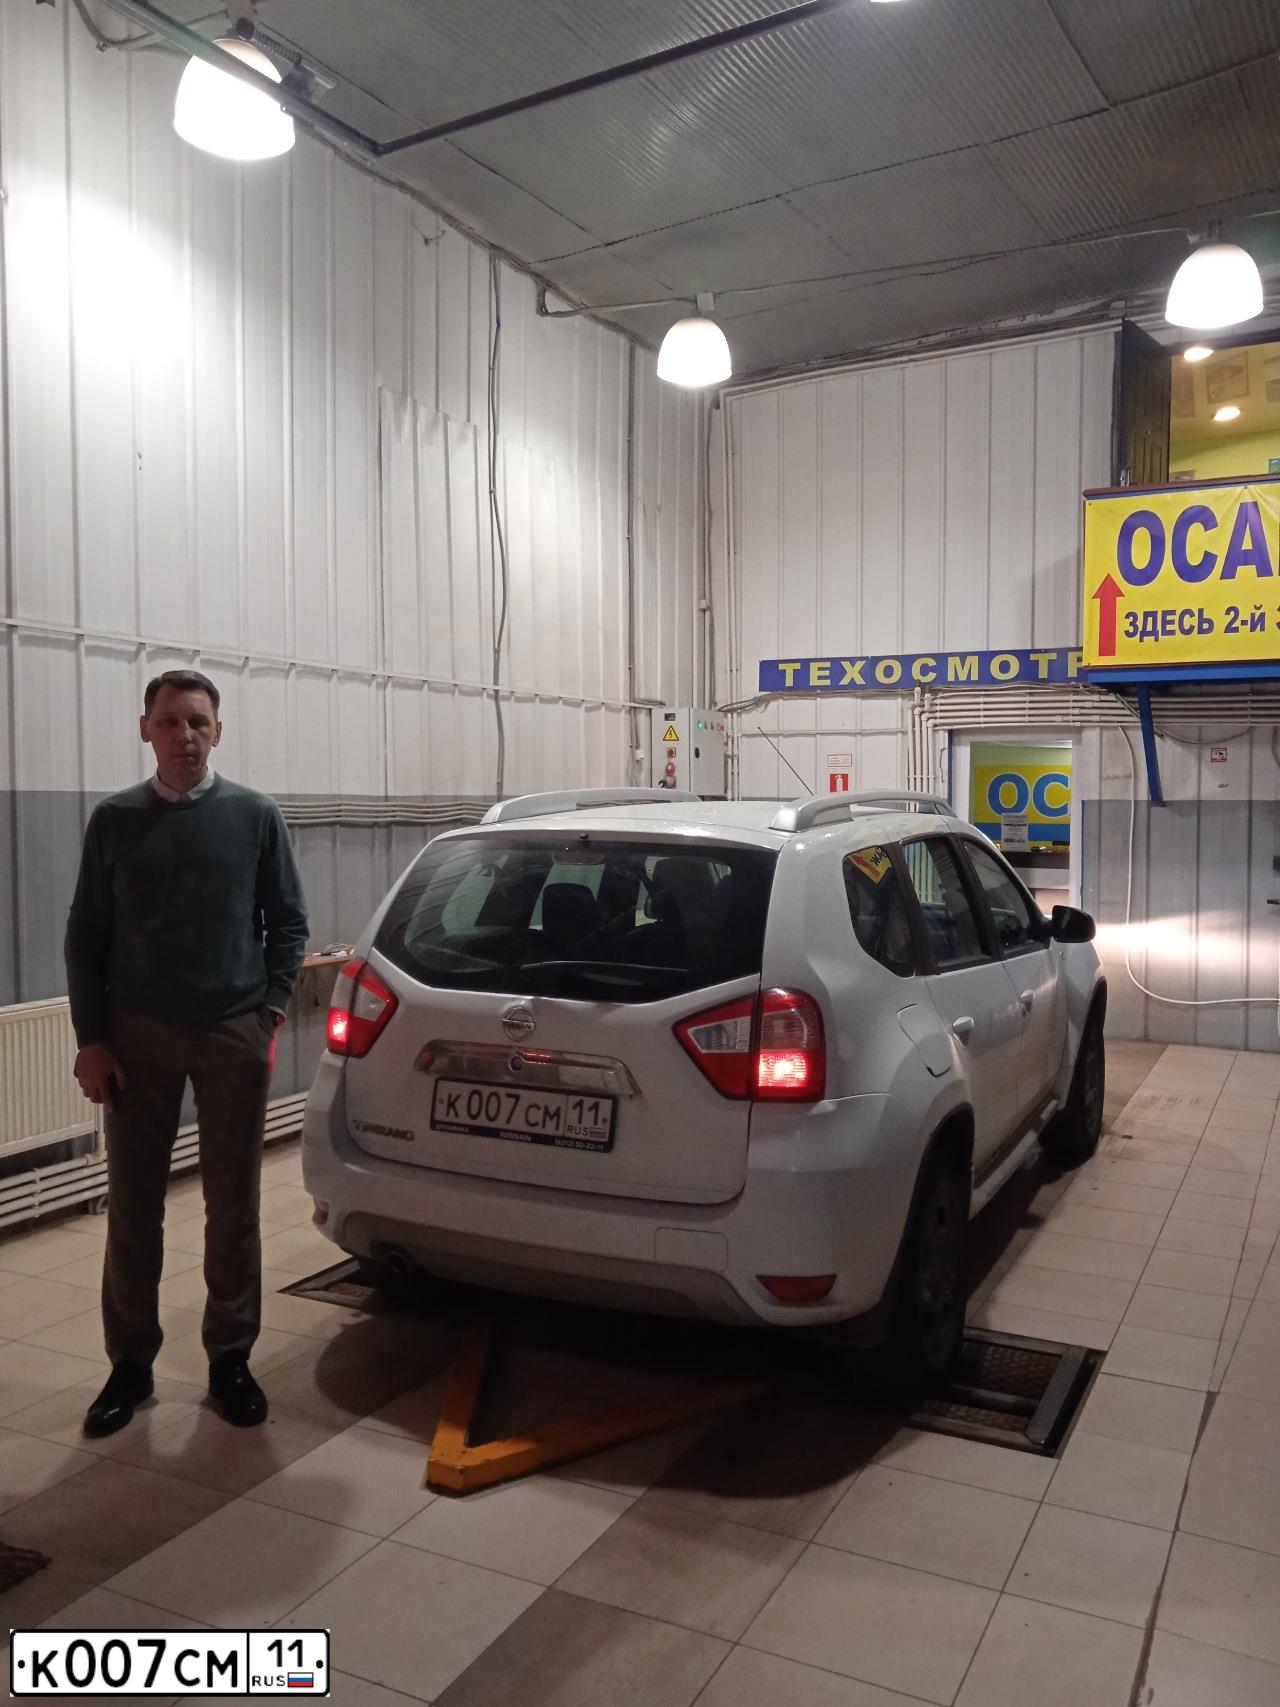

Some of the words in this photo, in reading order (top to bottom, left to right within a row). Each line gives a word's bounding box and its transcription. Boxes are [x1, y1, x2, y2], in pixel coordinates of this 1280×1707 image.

[1117, 501, 1280, 587] ОСА
[1124, 608, 1215, 643] ЗДЕСЬ
[1224, 604, 1266, 634] 2-й
[987, 772, 1070, 818] ОС
[567, 1125, 589, 1136] RUS
[572, 1098, 600, 1126] 11
